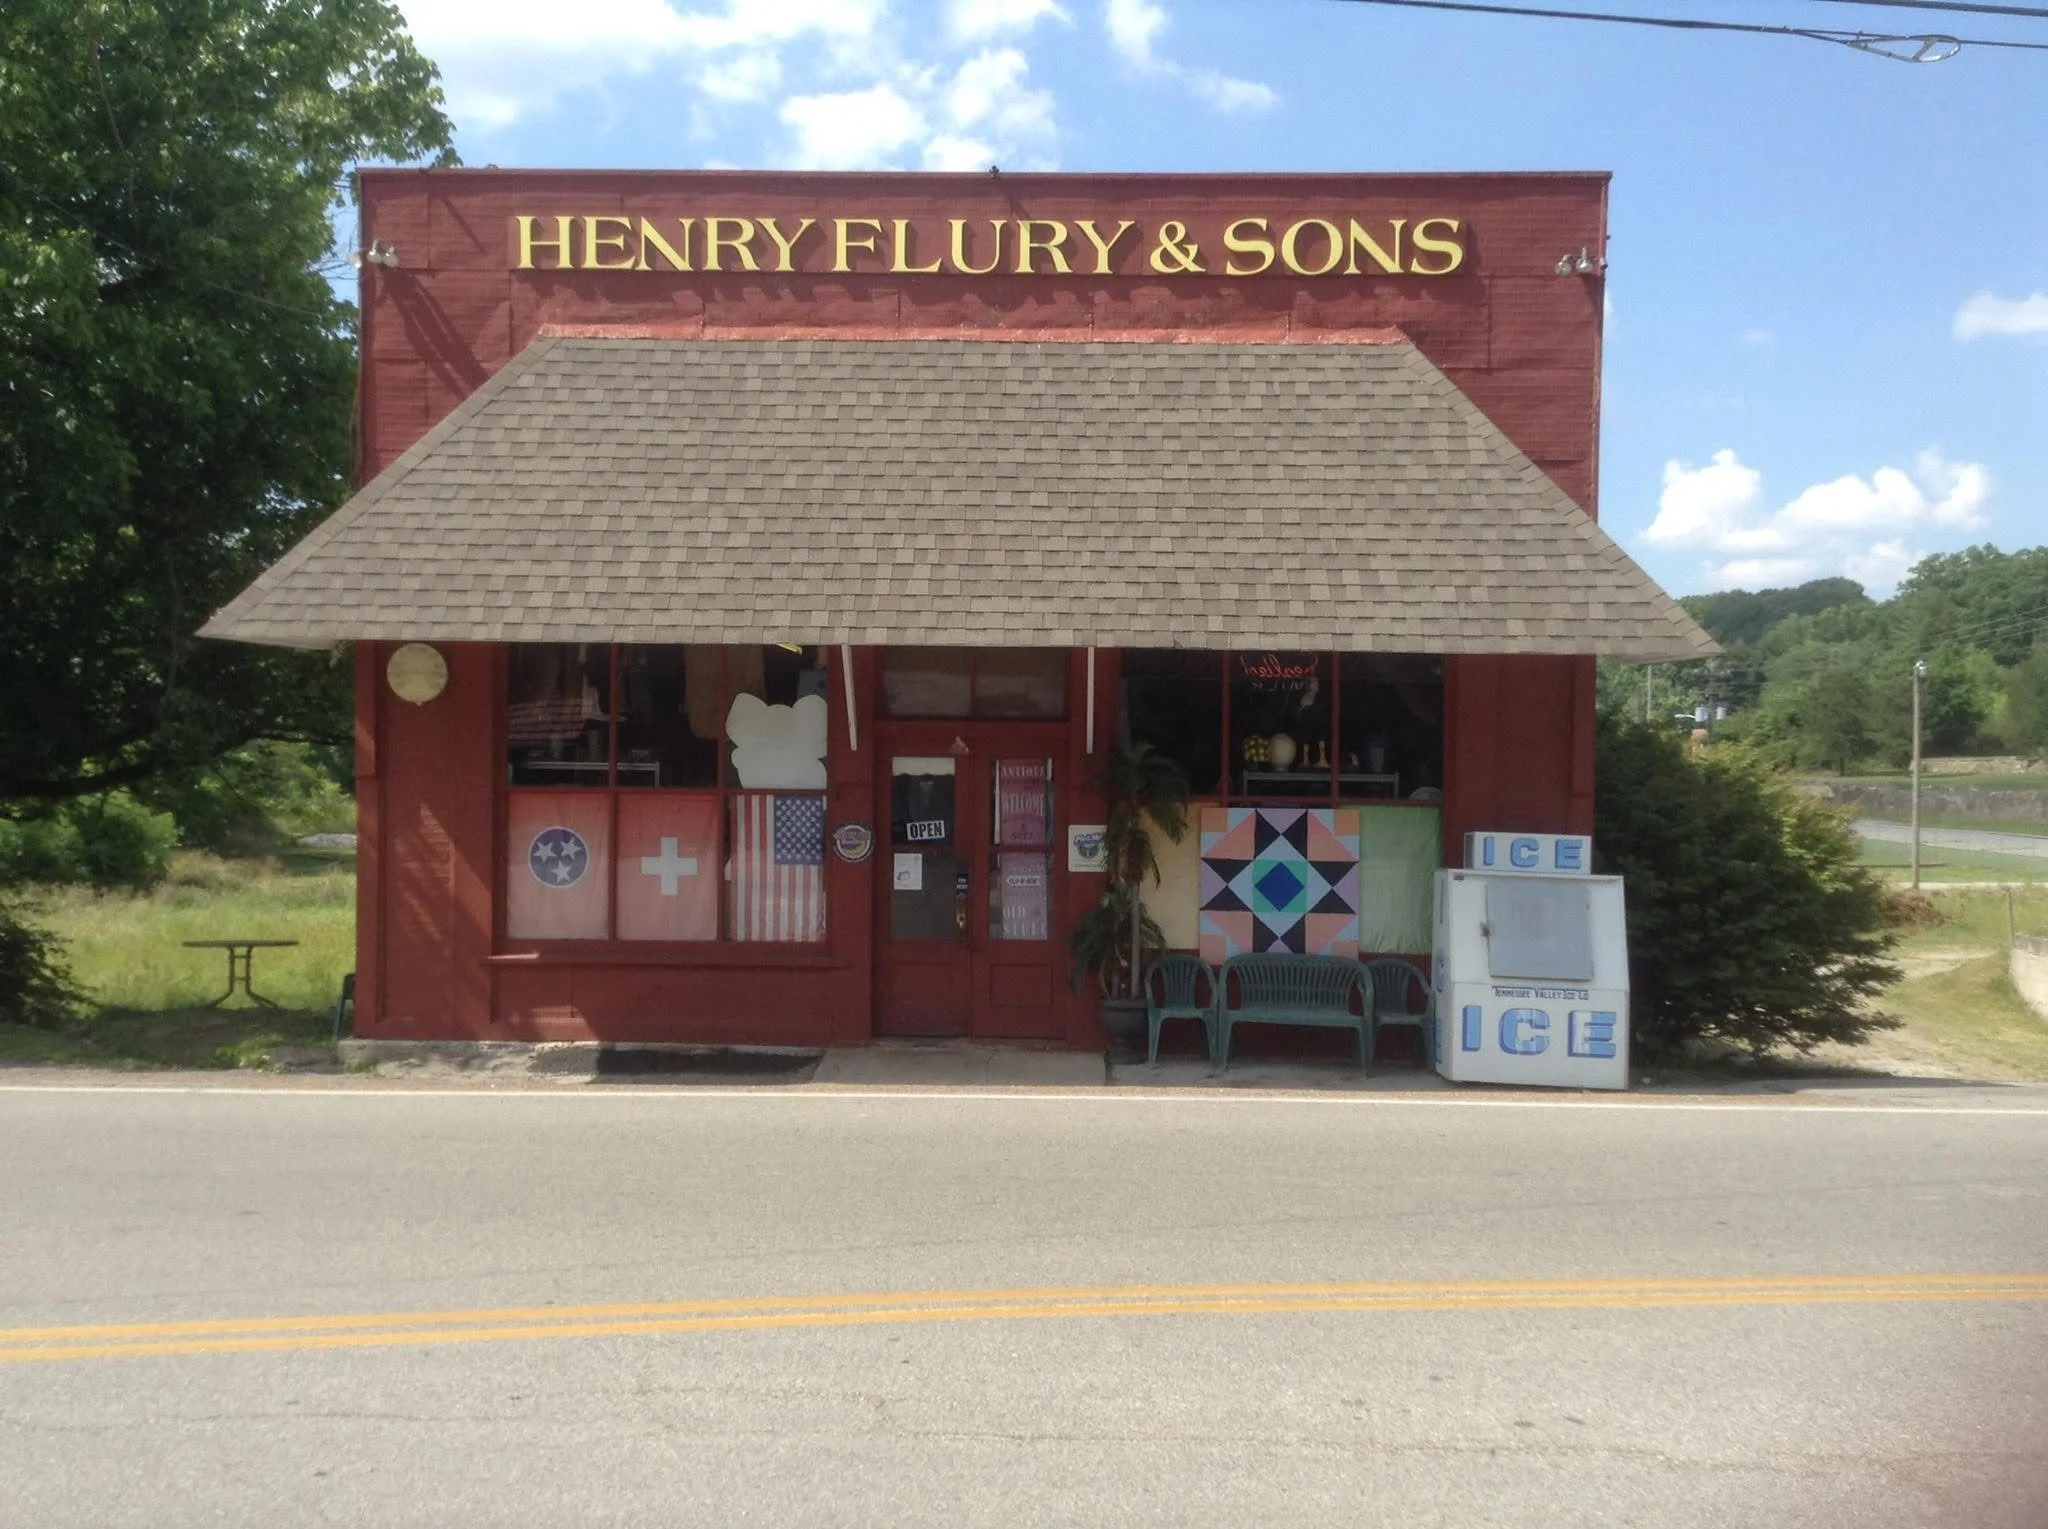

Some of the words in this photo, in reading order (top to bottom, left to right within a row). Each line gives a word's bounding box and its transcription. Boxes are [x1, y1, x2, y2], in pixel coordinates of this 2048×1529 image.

[515, 215, 817, 272] HENRY
[832, 218, 1136, 275] FLURY
[1149, 220, 1207, 275] &
[1223, 217, 1464, 276] SONS
[910, 821, 943, 839] OPEN
[1483, 836, 1583, 869] ICE
[1534, 987, 1562, 999] VALLEY
[1462, 1005, 1616, 1058] ICE
